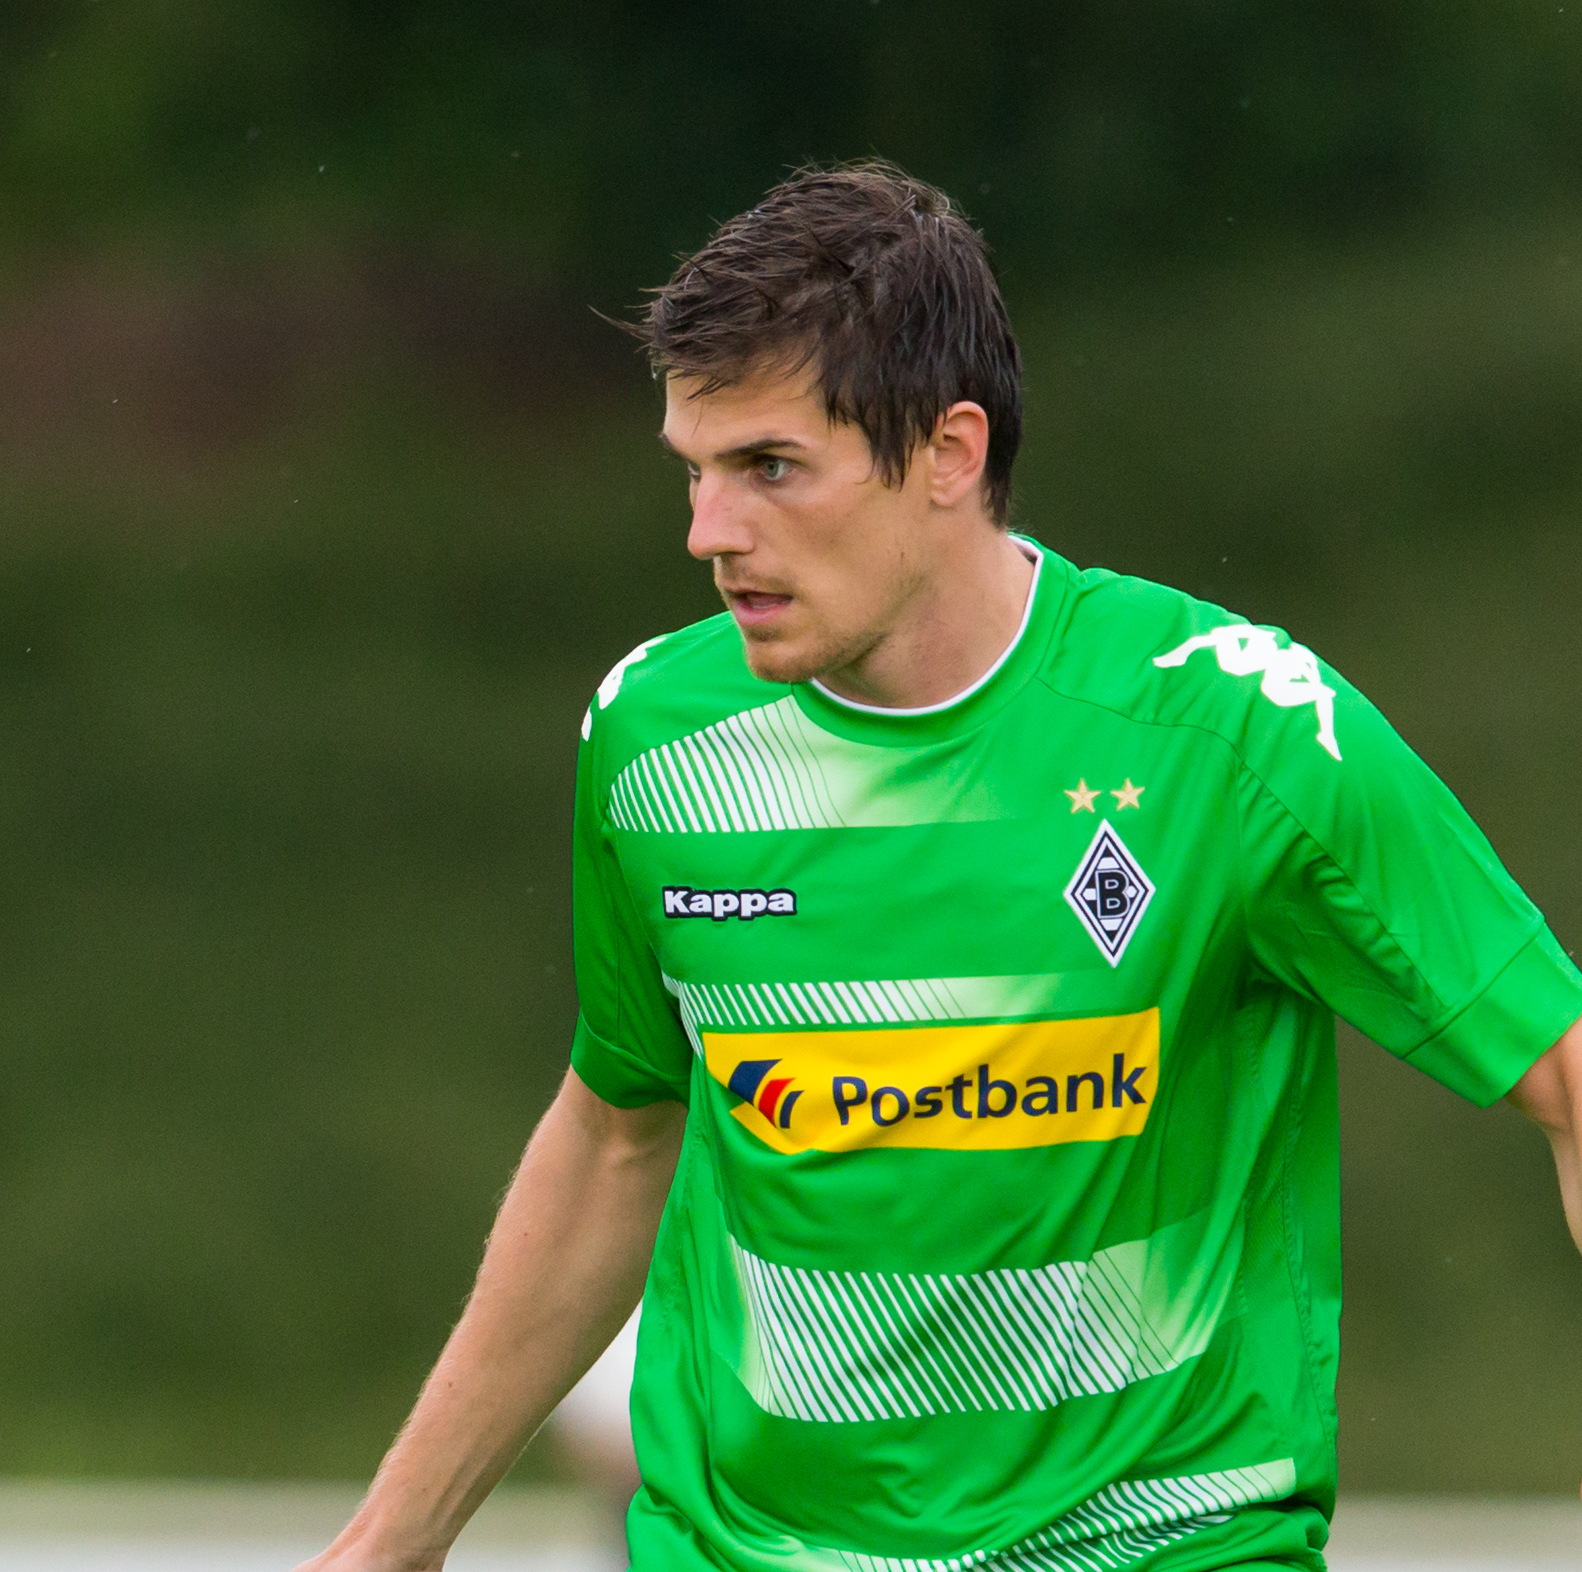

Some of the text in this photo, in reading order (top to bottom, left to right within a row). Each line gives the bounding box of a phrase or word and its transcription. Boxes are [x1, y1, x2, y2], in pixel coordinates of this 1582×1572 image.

[663, 888, 796, 919] Kappa
[1095, 869, 1131, 919] B
[831, 1052, 1148, 1127] Postbank
